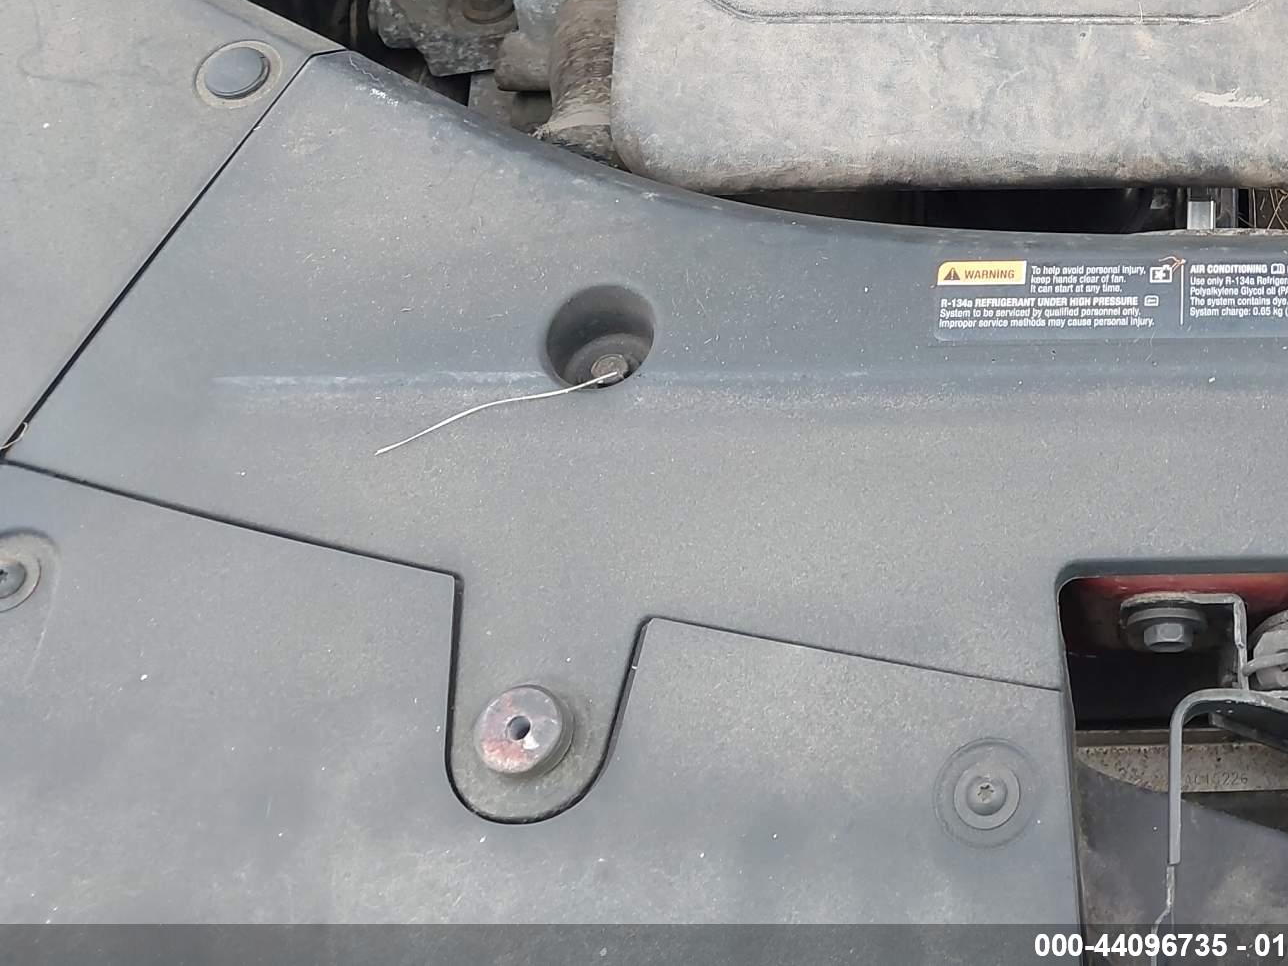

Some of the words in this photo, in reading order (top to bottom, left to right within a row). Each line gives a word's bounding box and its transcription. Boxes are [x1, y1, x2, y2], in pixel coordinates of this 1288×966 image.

[964, 269, 1015, 279] WARNING
[1032, 266, 1041, 275] To
[1190, 265, 1205, 274] AIR
[1207, 264, 1268, 274] CONDITIONING
[1226, 276, 1255, 285] R-134a
[1075, 285, 1084, 293] at
[941, 298, 973, 308] R-134a
[975, 298, 1036, 307] REFRIGERANT
[1038, 297, 1067, 307] UNDER
[1070, 297, 1090, 306] HIGH
[1093, 296, 1139, 306] PRESSURE
[940, 309, 971, 319] System
[973, 309, 981, 317] to
[983, 308, 993, 317] be
[1033, 308, 1042, 318] by
[1190, 308, 1220, 318] System
[1253, 307, 1271, 315] 0.65
[1273, 307, 1283, 317] kg
